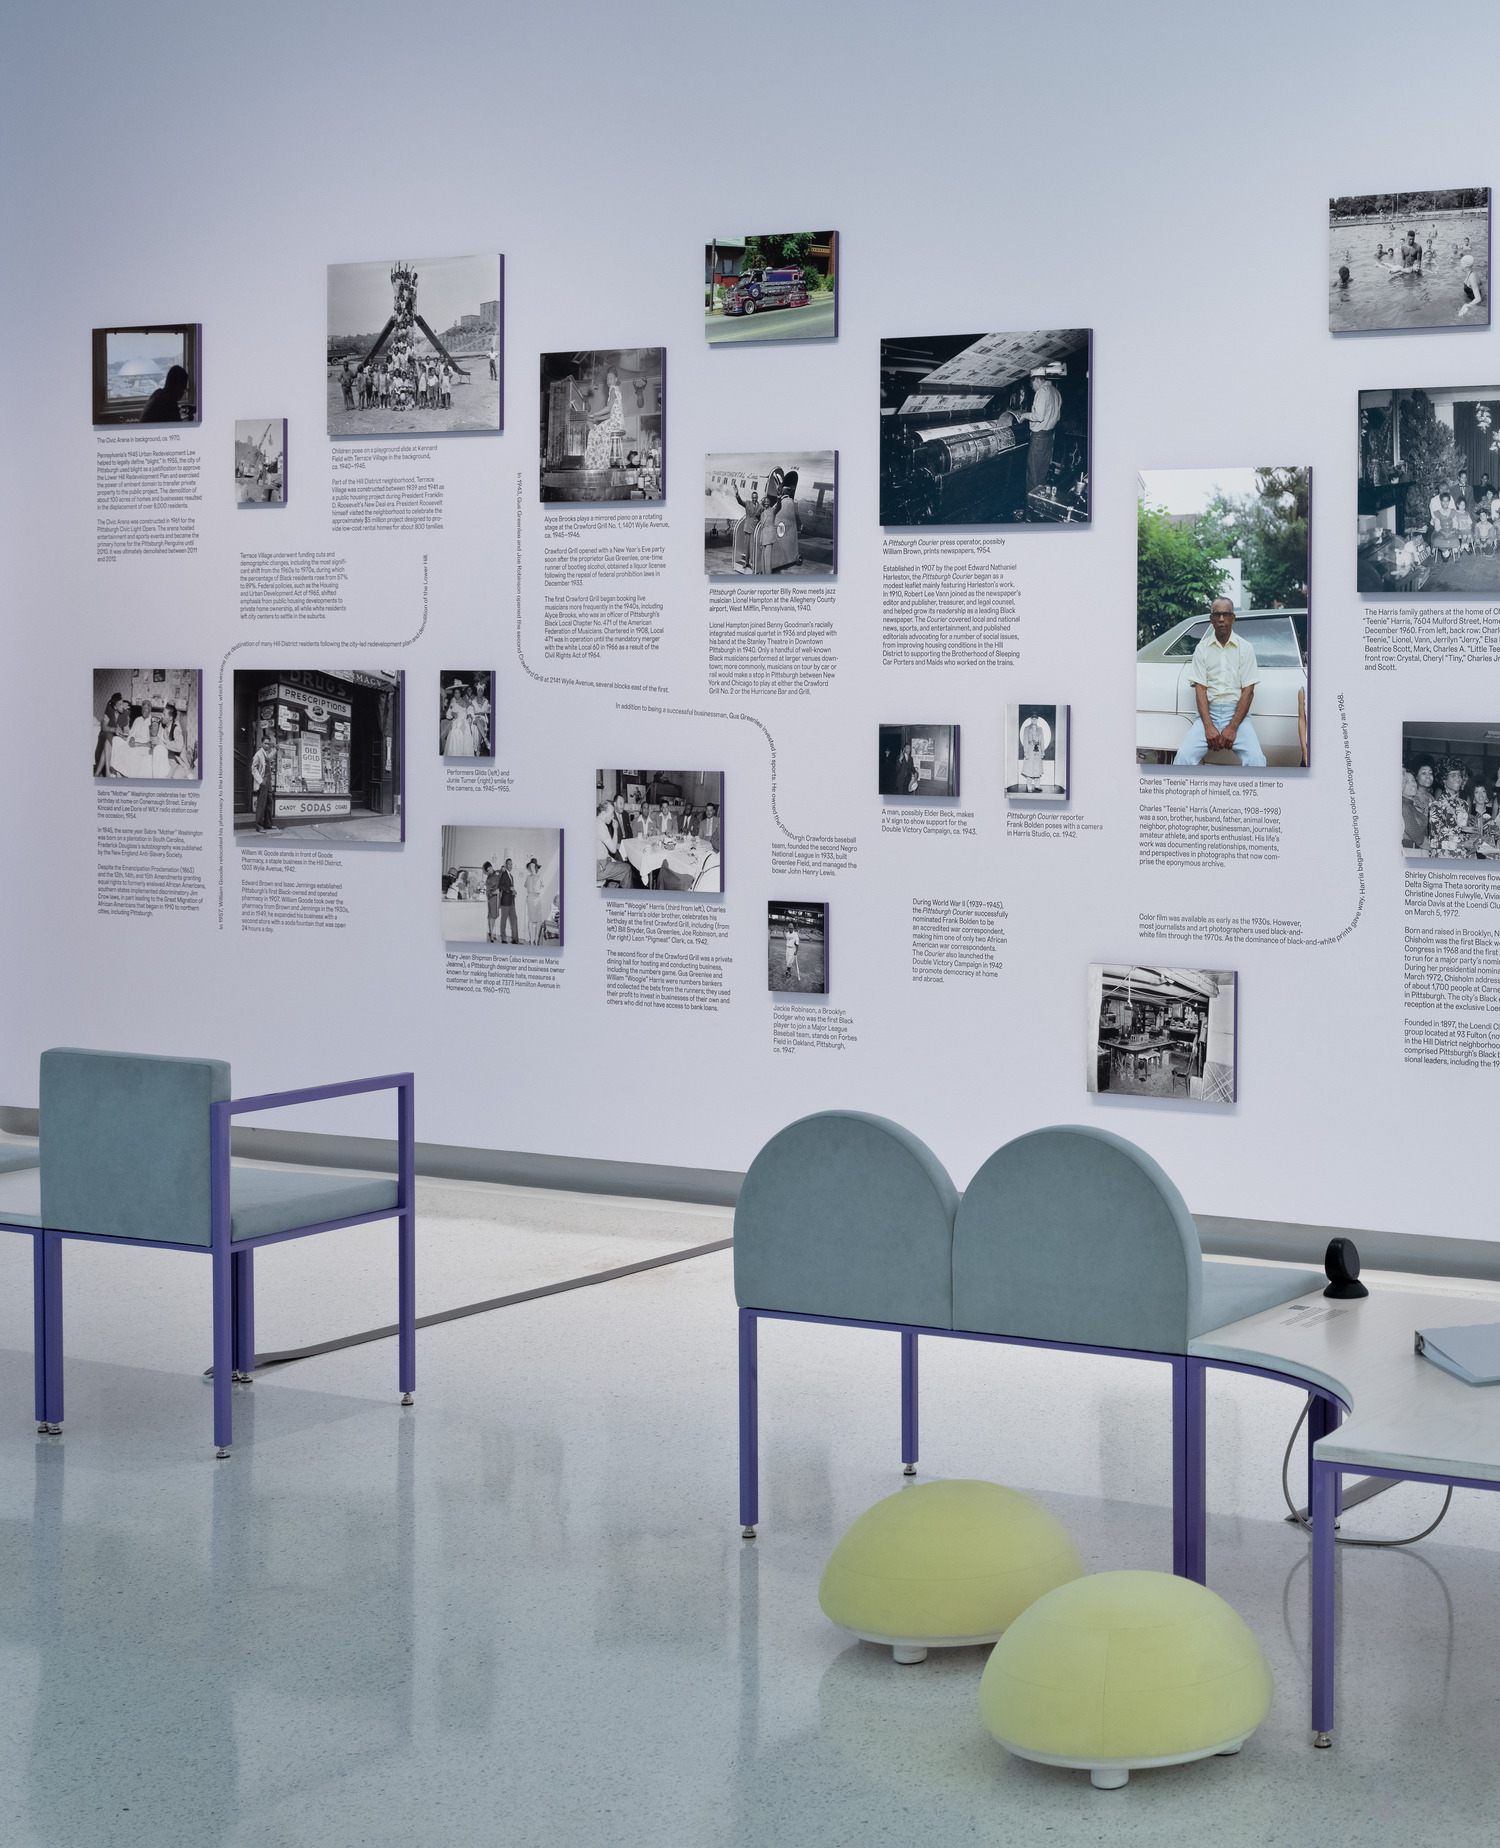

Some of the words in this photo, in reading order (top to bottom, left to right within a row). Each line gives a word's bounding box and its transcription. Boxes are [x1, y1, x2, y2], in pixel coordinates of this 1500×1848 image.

[134, 435, 161, 443] background,
[373, 445, 400, 454] playground
[888, 539, 917, 548] Pittsburgh
[917, 538, 939, 546] Courier
[939, 539, 955, 547] press
[956, 538, 981, 546] operator,
[982, 537, 1005, 546] possibly
[708, 588, 736, 596] Pittsburgh
[757, 588, 780, 596] reporter
[780, 587, 791, 596] Billy
[824, 587, 836, 595] jazz
[1364, 607, 1377, 615] The
[1399, 608, 1417, 616] family
[1419, 608, 1444, 617] gathers
[1484, 607, 1492, 615] of
[285, 689, 347, 712] PRESCRIPTIONS
[305, 747, 317, 755] OLD
[303, 754, 320, 762] GOLD
[474, 768, 486, 776] Gilda
[487, 768, 500, 776] (left)
[1165, 787, 1200, 796] photograph
[1200, 787, 1207, 795] of
[1208, 788, 1231, 796] himself,
[1242, 788, 1258, 796] 1975.
[301, 803, 332, 812] SODAS
[1006, 811, 1036, 821] Pittsburgh
[1037, 812, 1059, 820] Courier
[1059, 813, 1084, 822] reporter
[1404, 870, 1427, 880] Shirley
[1427, 871, 1457, 880] Chisholm
[1458, 873, 1486, 881] receives
[912, 897, 931, 907] During
[931, 898, 949, 906] World
[949, 899, 961, 907] War
[772, 1004, 790, 1012] Jackie
[790, 1005, 817, 1014] Robinson,
[821, 1007, 846, 1016] Brooklyn
